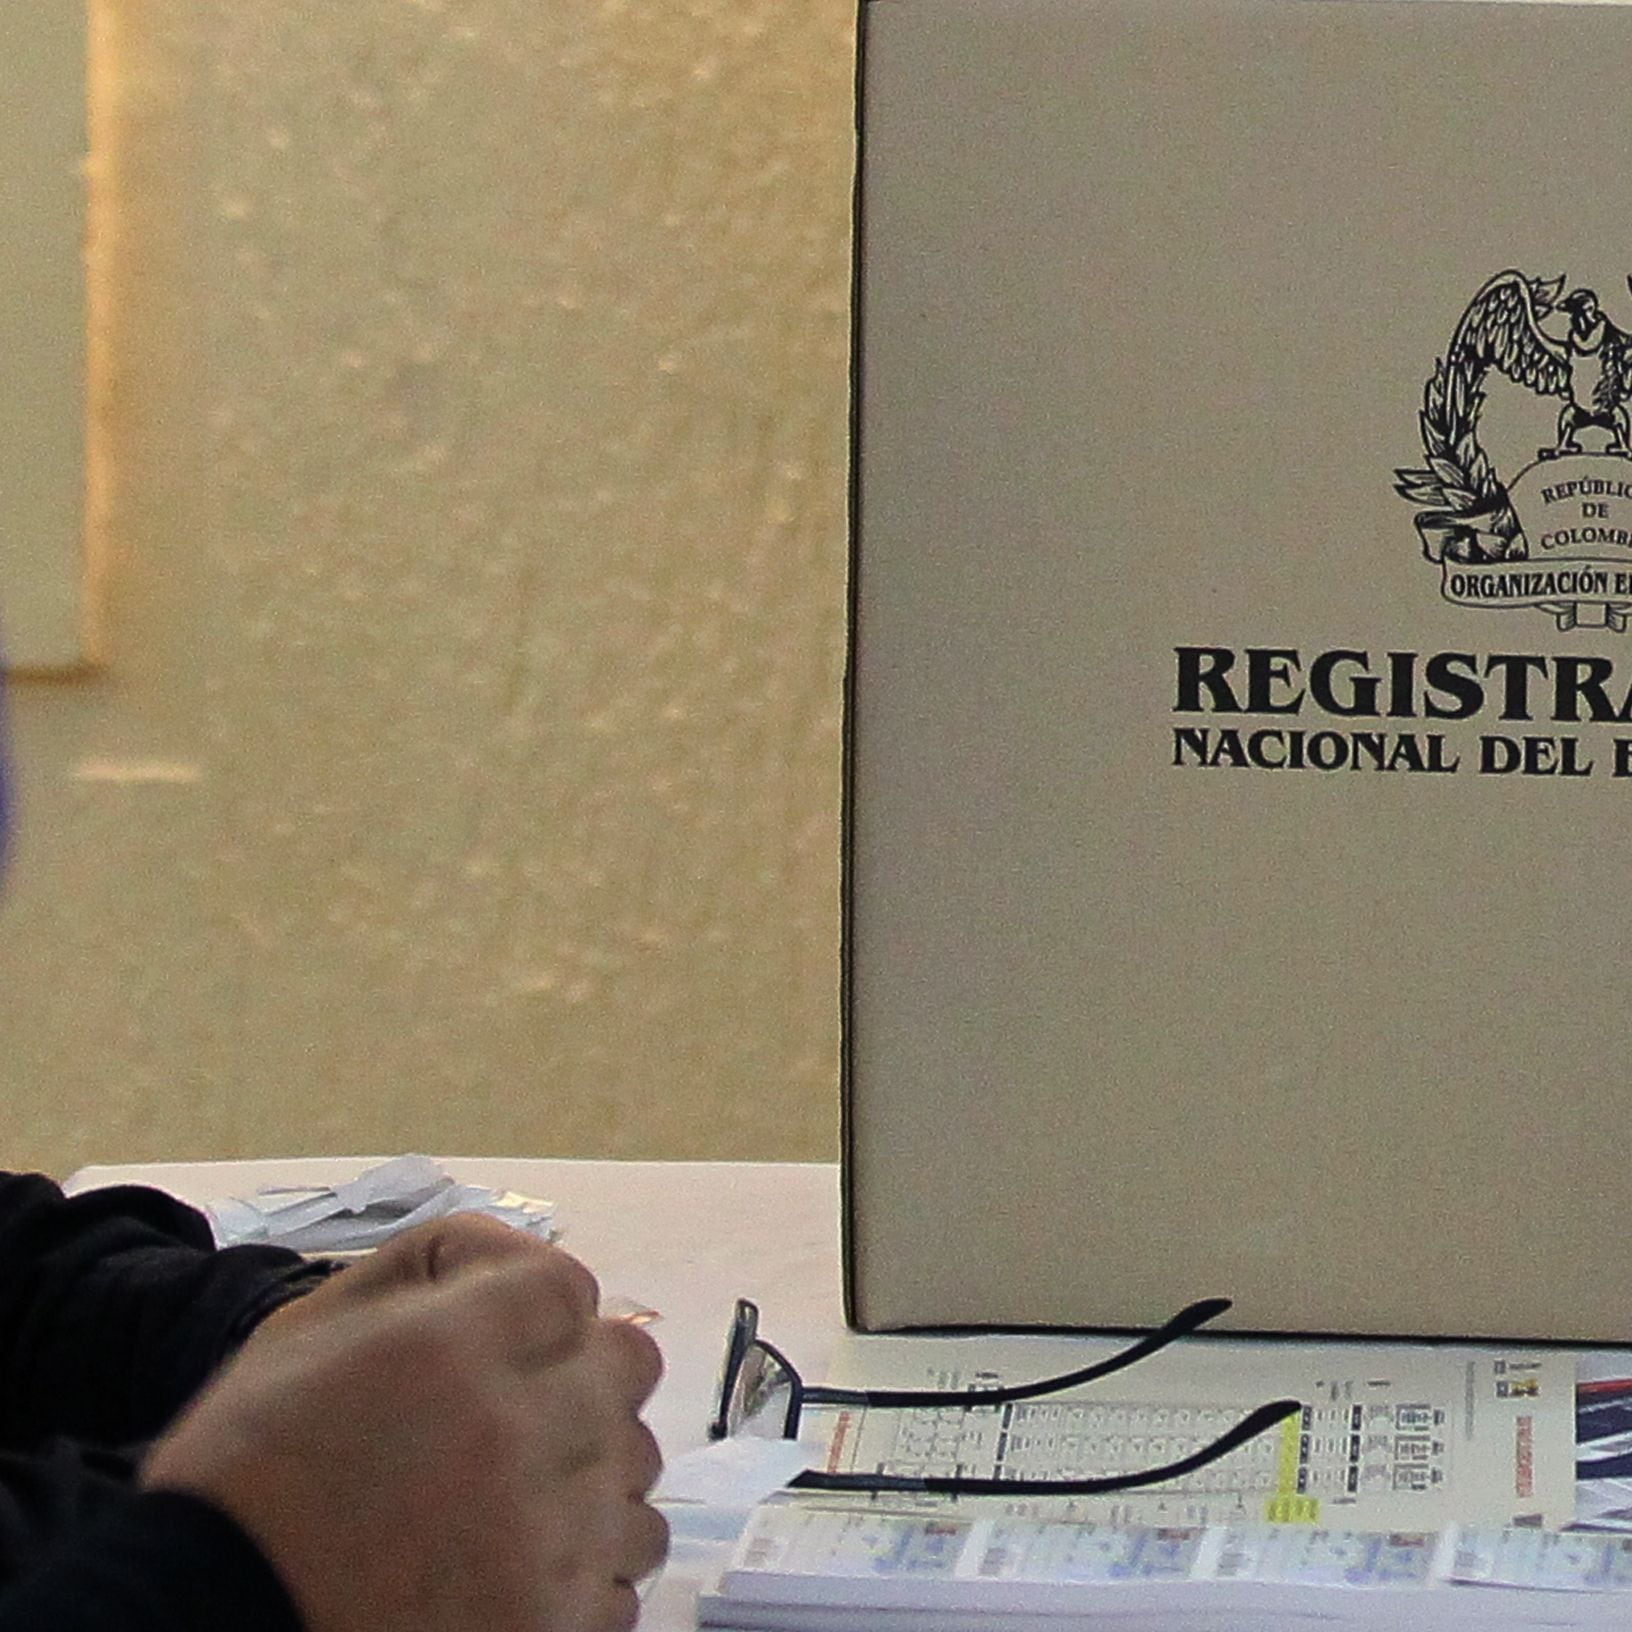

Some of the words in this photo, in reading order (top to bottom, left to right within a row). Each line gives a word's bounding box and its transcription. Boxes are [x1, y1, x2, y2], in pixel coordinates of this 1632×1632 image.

[1581, 501, 1609, 519] DE
[1450, 565, 1608, 599] ORGANIZACIÓN
[1171, 727, 1461, 776] NACIONAL
[1479, 734, 1593, 778] DEL
